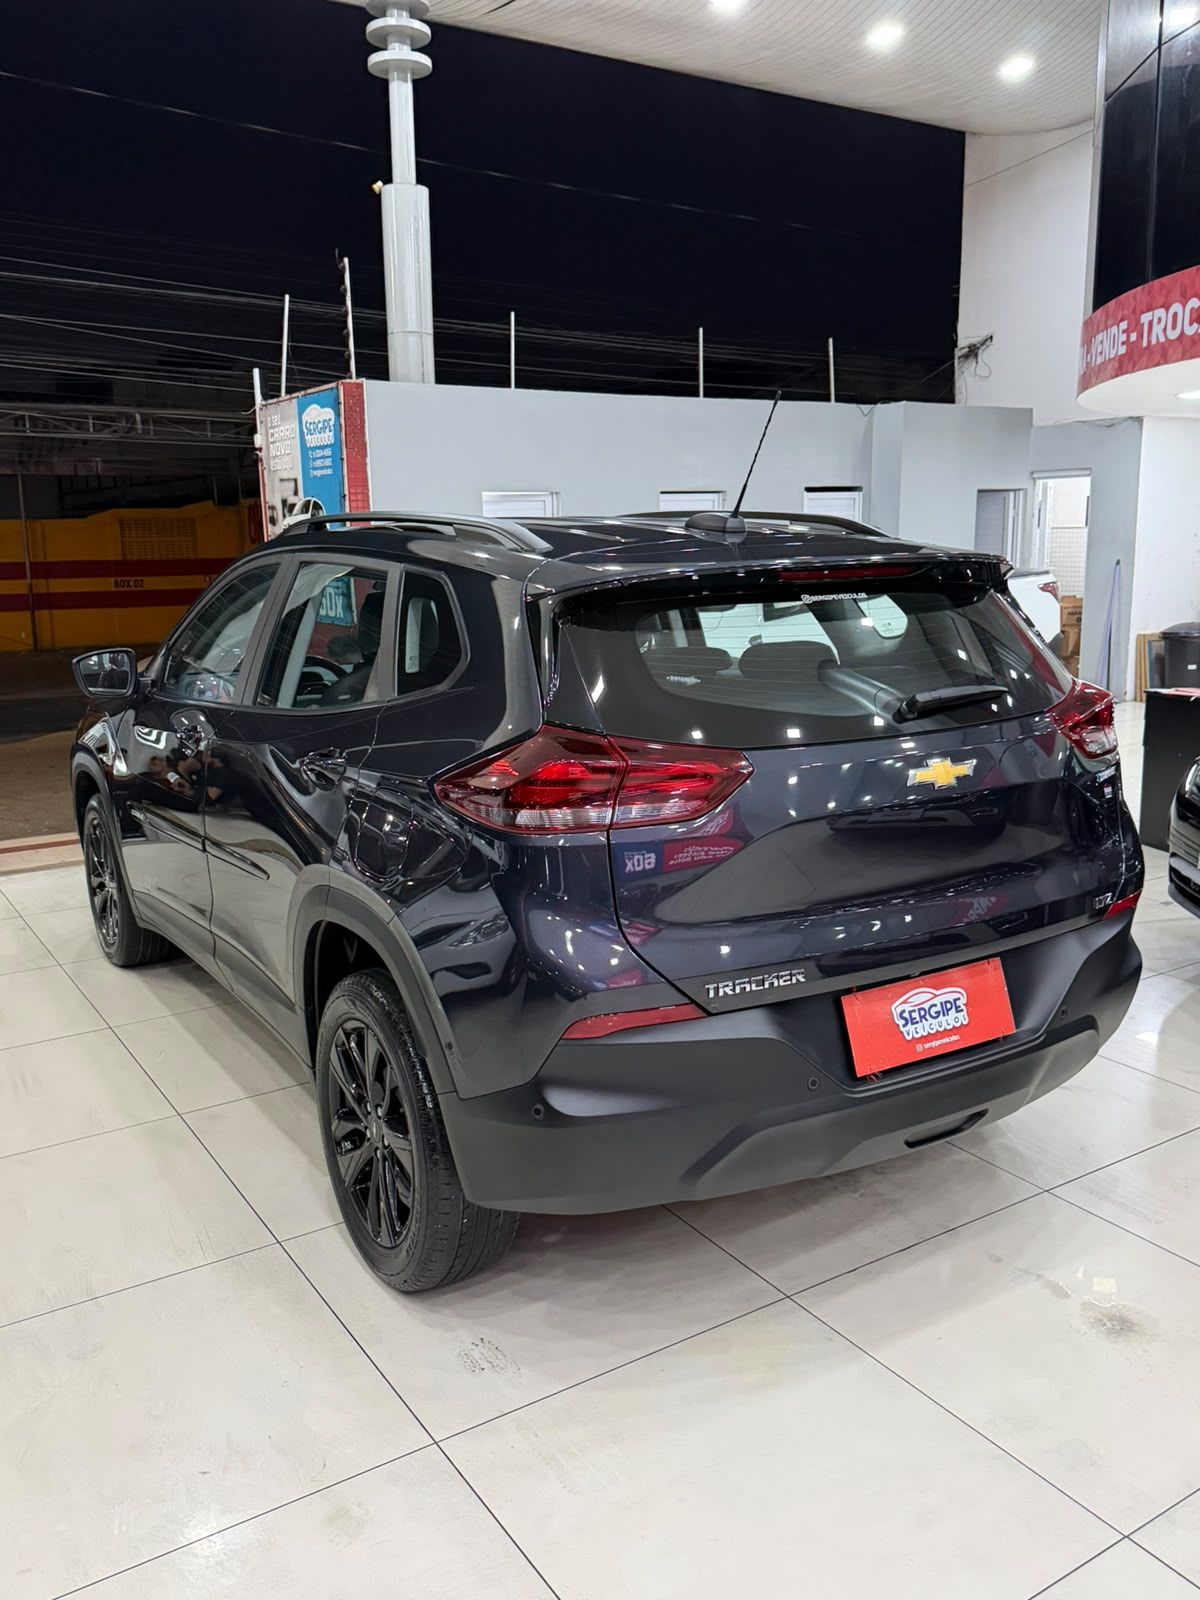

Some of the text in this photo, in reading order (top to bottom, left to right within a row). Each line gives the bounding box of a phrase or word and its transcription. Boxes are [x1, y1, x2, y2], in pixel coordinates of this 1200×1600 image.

[1091, 320, 1128, 367] VENDE
[1140, 297, 1200, 348] TROC
[268, 424, 296, 442] CARRO
[305, 418, 333, 436] SERGIPE
[270, 440, 291, 457] NOVO
[113, 578, 145, 589] BOX 02
[704, 968, 807, 999] TRACKER
[898, 996, 964, 1028] SERGIPE
